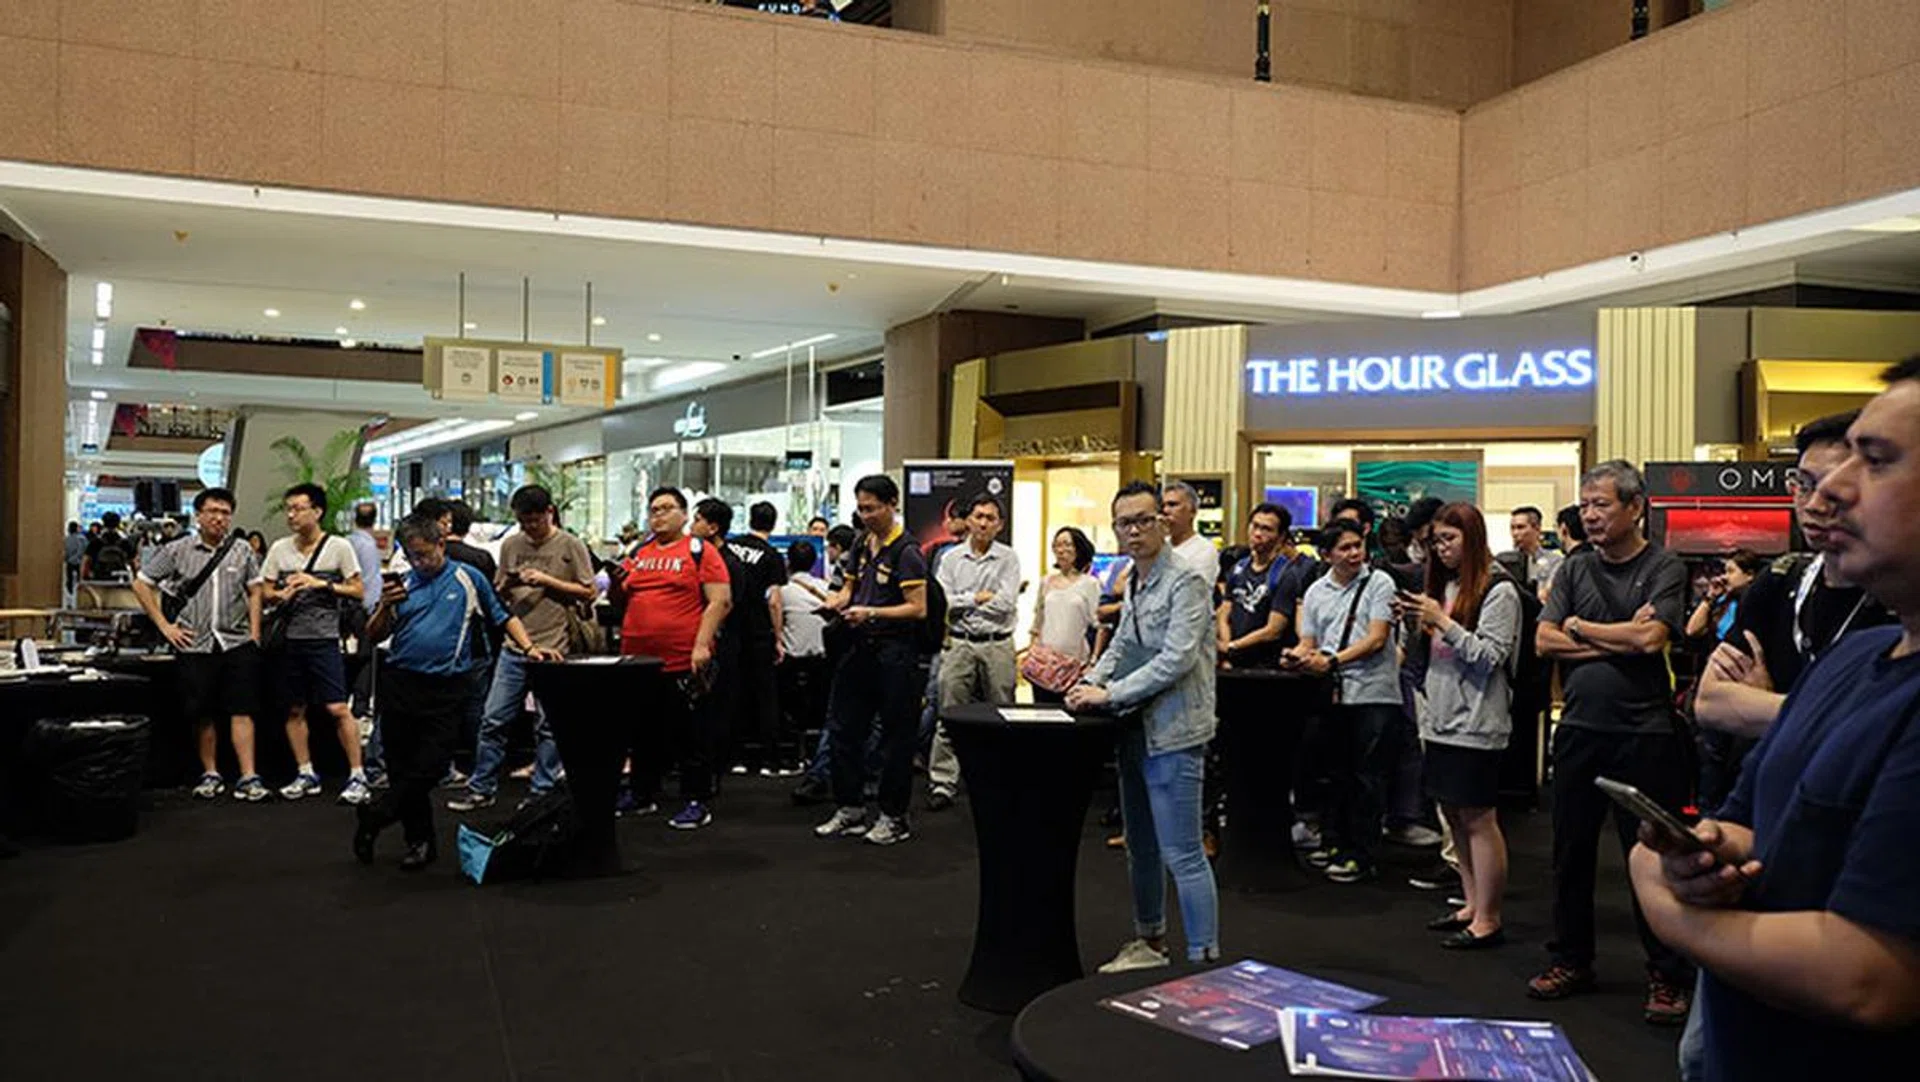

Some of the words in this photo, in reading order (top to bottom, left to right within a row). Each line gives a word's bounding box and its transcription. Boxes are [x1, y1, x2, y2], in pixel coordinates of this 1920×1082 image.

[1246, 359, 1320, 393] THE
[1327, 355, 1450, 392] HOUR
[1453, 350, 1593, 387] GLASS
